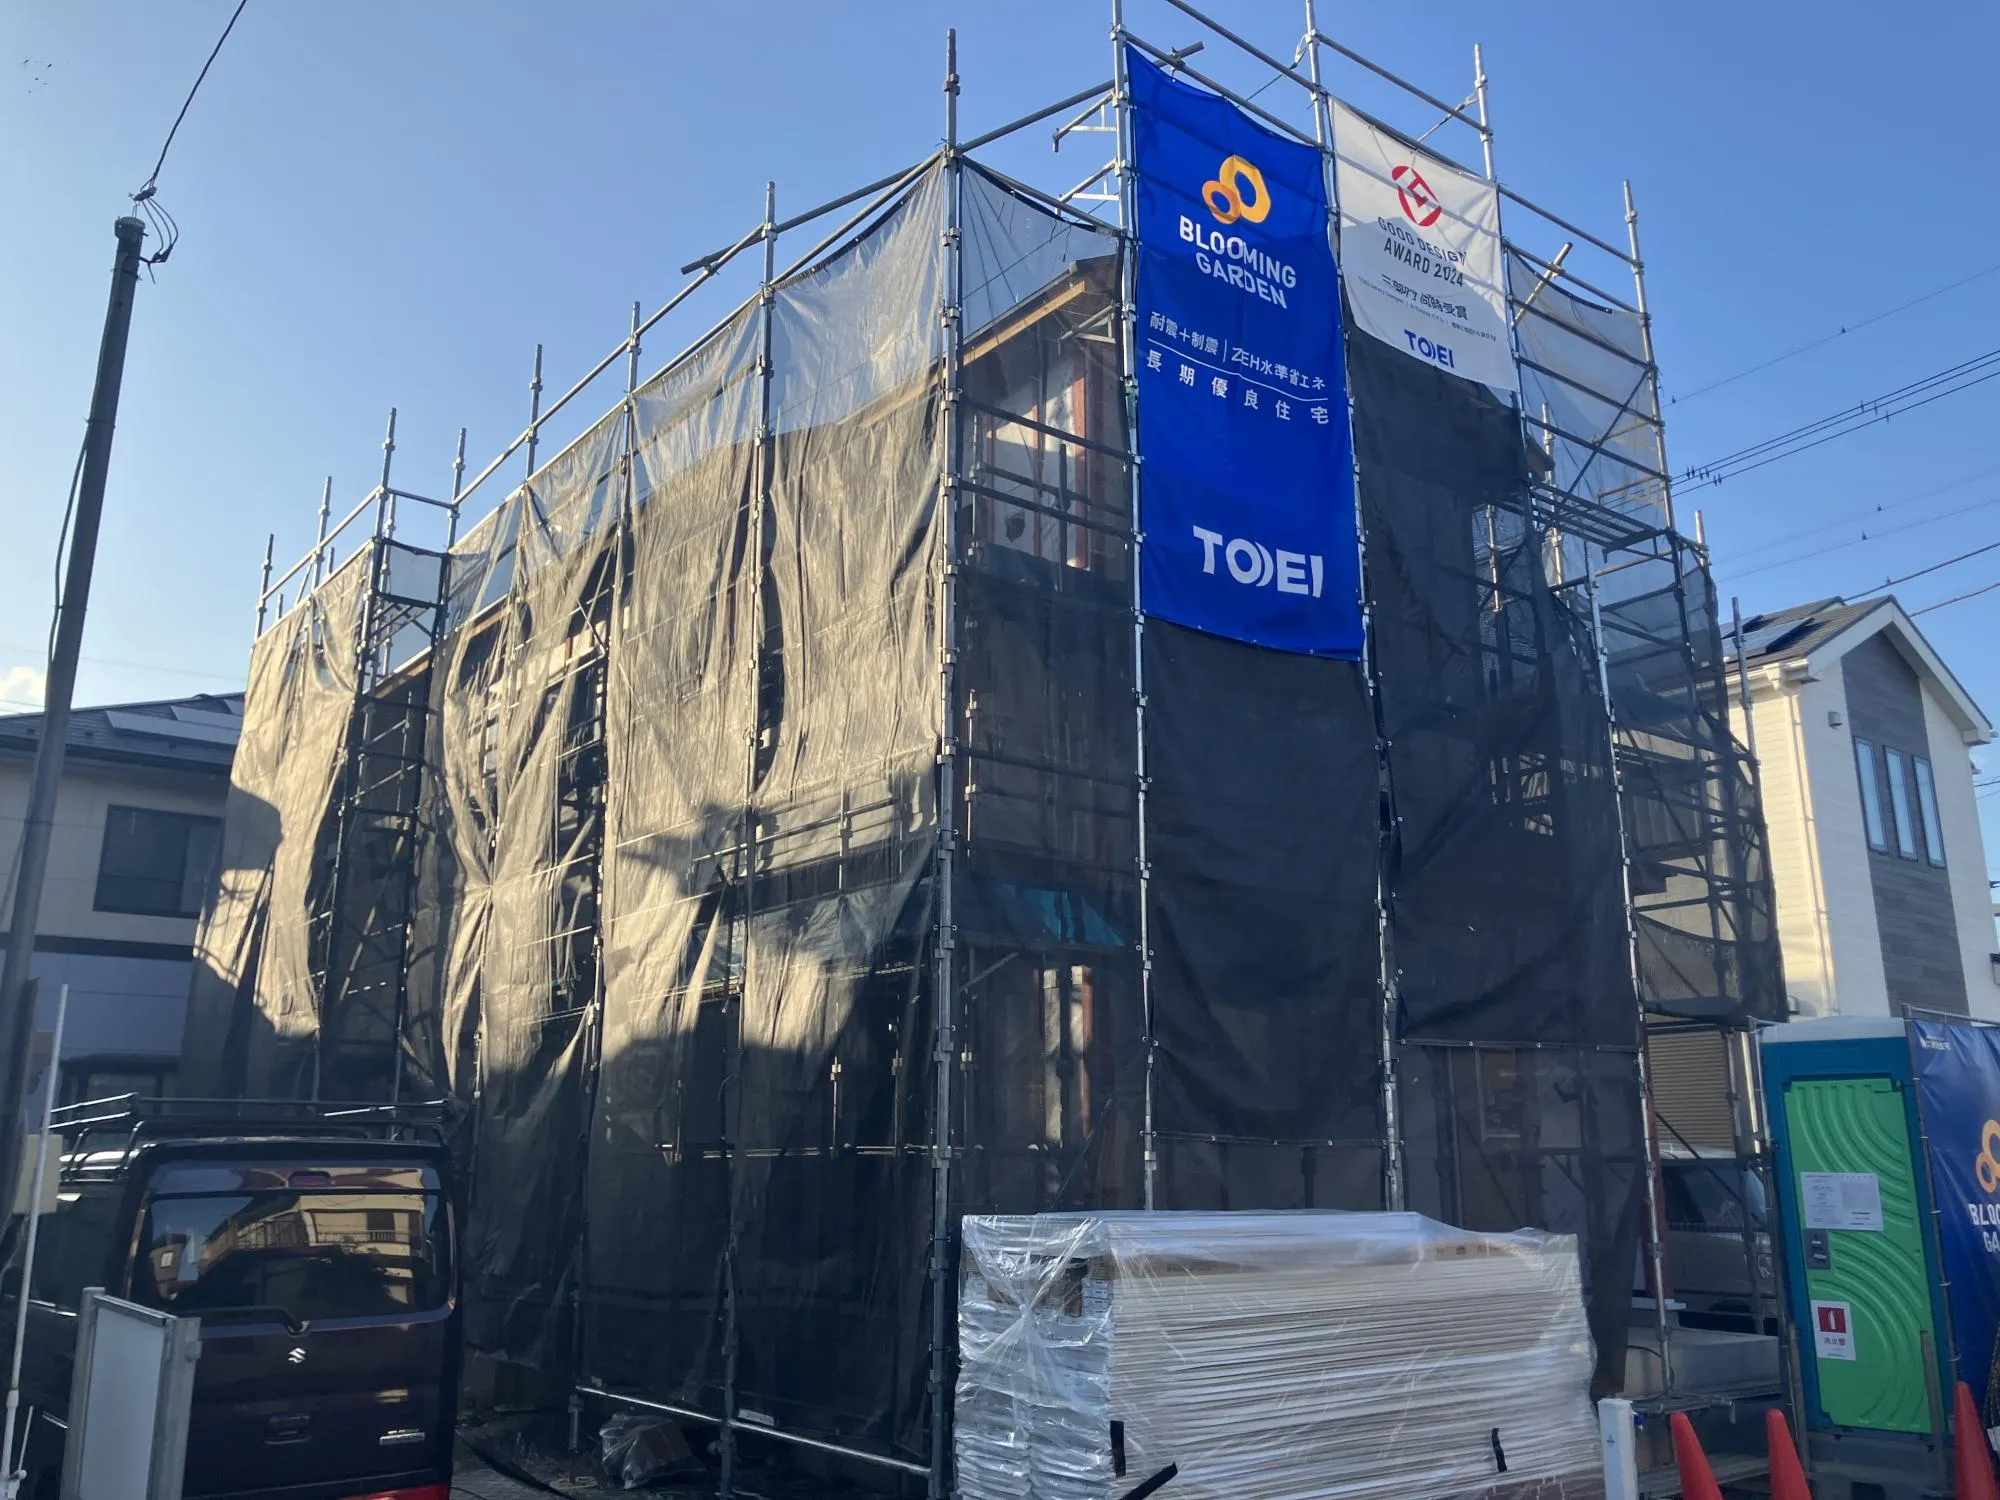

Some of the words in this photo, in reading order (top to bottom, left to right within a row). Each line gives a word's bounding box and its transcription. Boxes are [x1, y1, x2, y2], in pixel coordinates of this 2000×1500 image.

[1180, 215, 1296, 288] BLOOMING
[1377, 216, 1414, 245] GOOD
[1196, 252, 1287, 309] GARDEN
[1383, 237, 1430, 274] AWARD
[1433, 262, 1464, 288] 2024
[1404, 328, 1455, 368] TOEI
[1146, 349, 1329, 425] 長期優良住宅
[1192, 525, 1324, 598] TOEI
